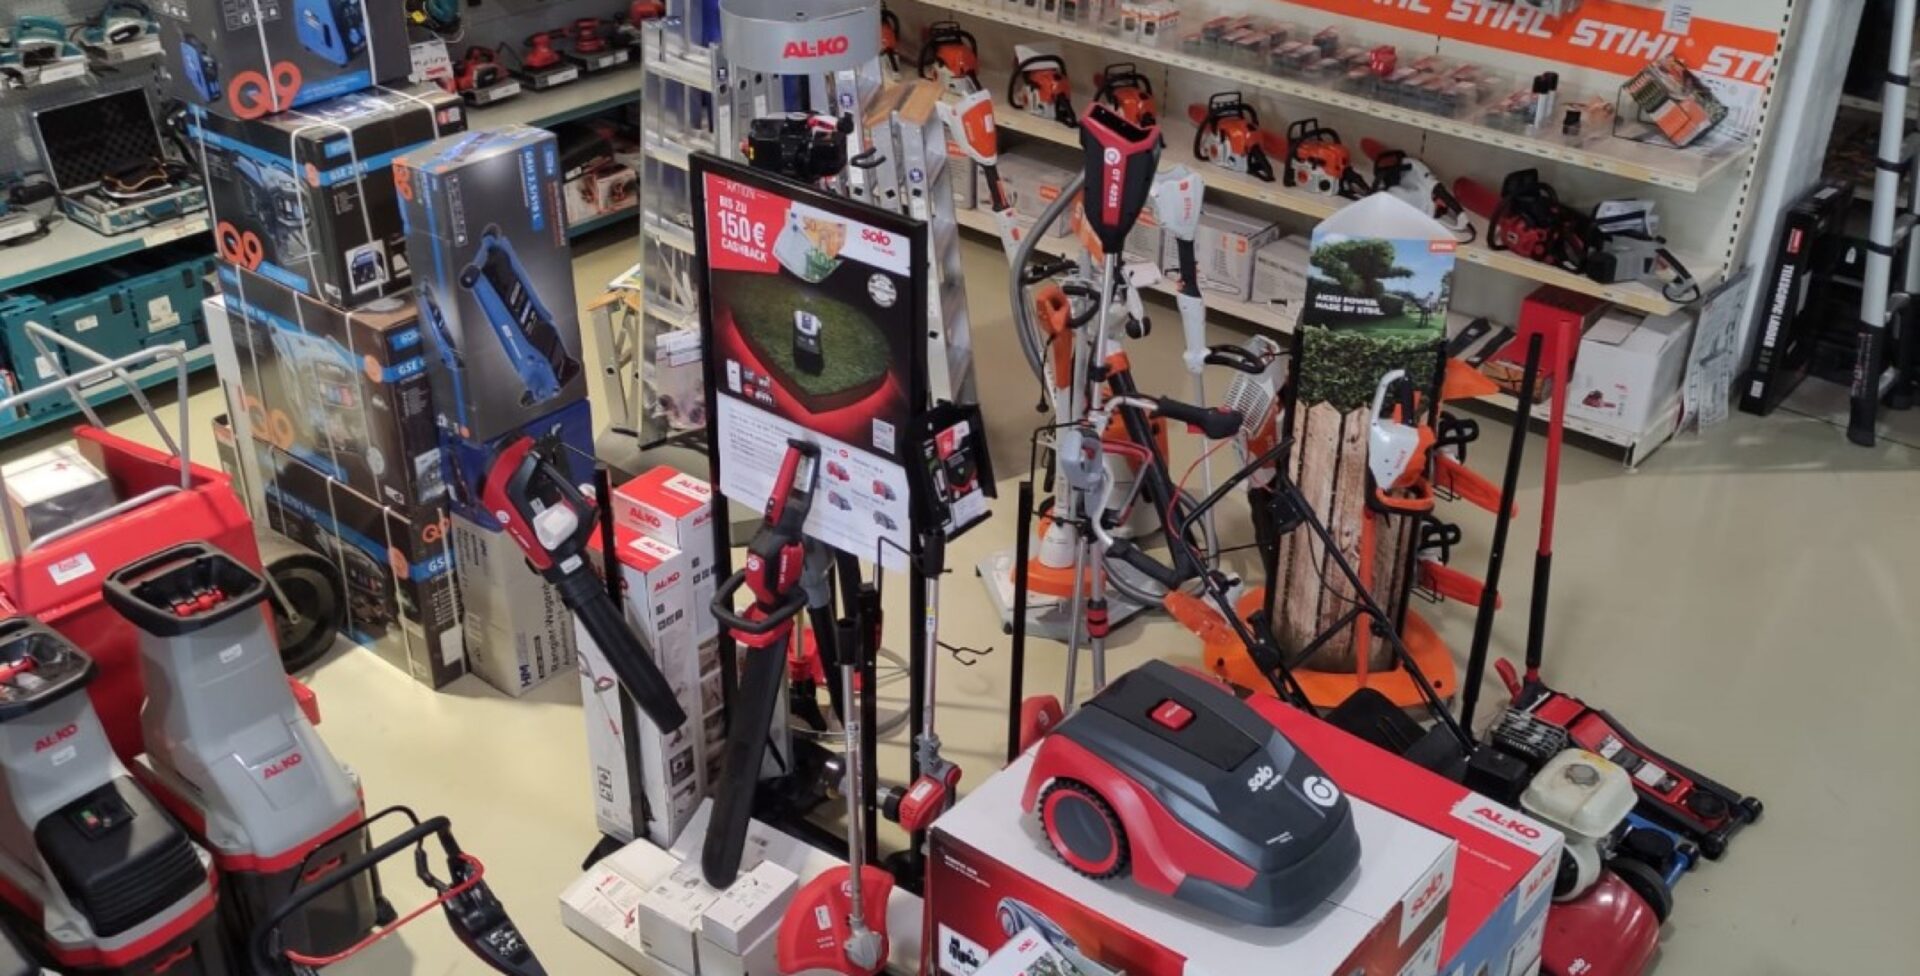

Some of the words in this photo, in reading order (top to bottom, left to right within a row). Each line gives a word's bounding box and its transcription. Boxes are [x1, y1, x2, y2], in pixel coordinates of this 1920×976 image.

[1446, 0, 1553, 39] STIHL
[1569, 18, 1680, 62] STIHL
[229, 61, 302, 120] Q9
[719, 195, 734, 210] BIS
[735, 200, 748, 215] ZU
[217, 221, 263, 272] Q9
[862, 228, 891, 247] solo
[692, 511, 712, 527] AL-K
[1247, 766, 1273, 792] solo
